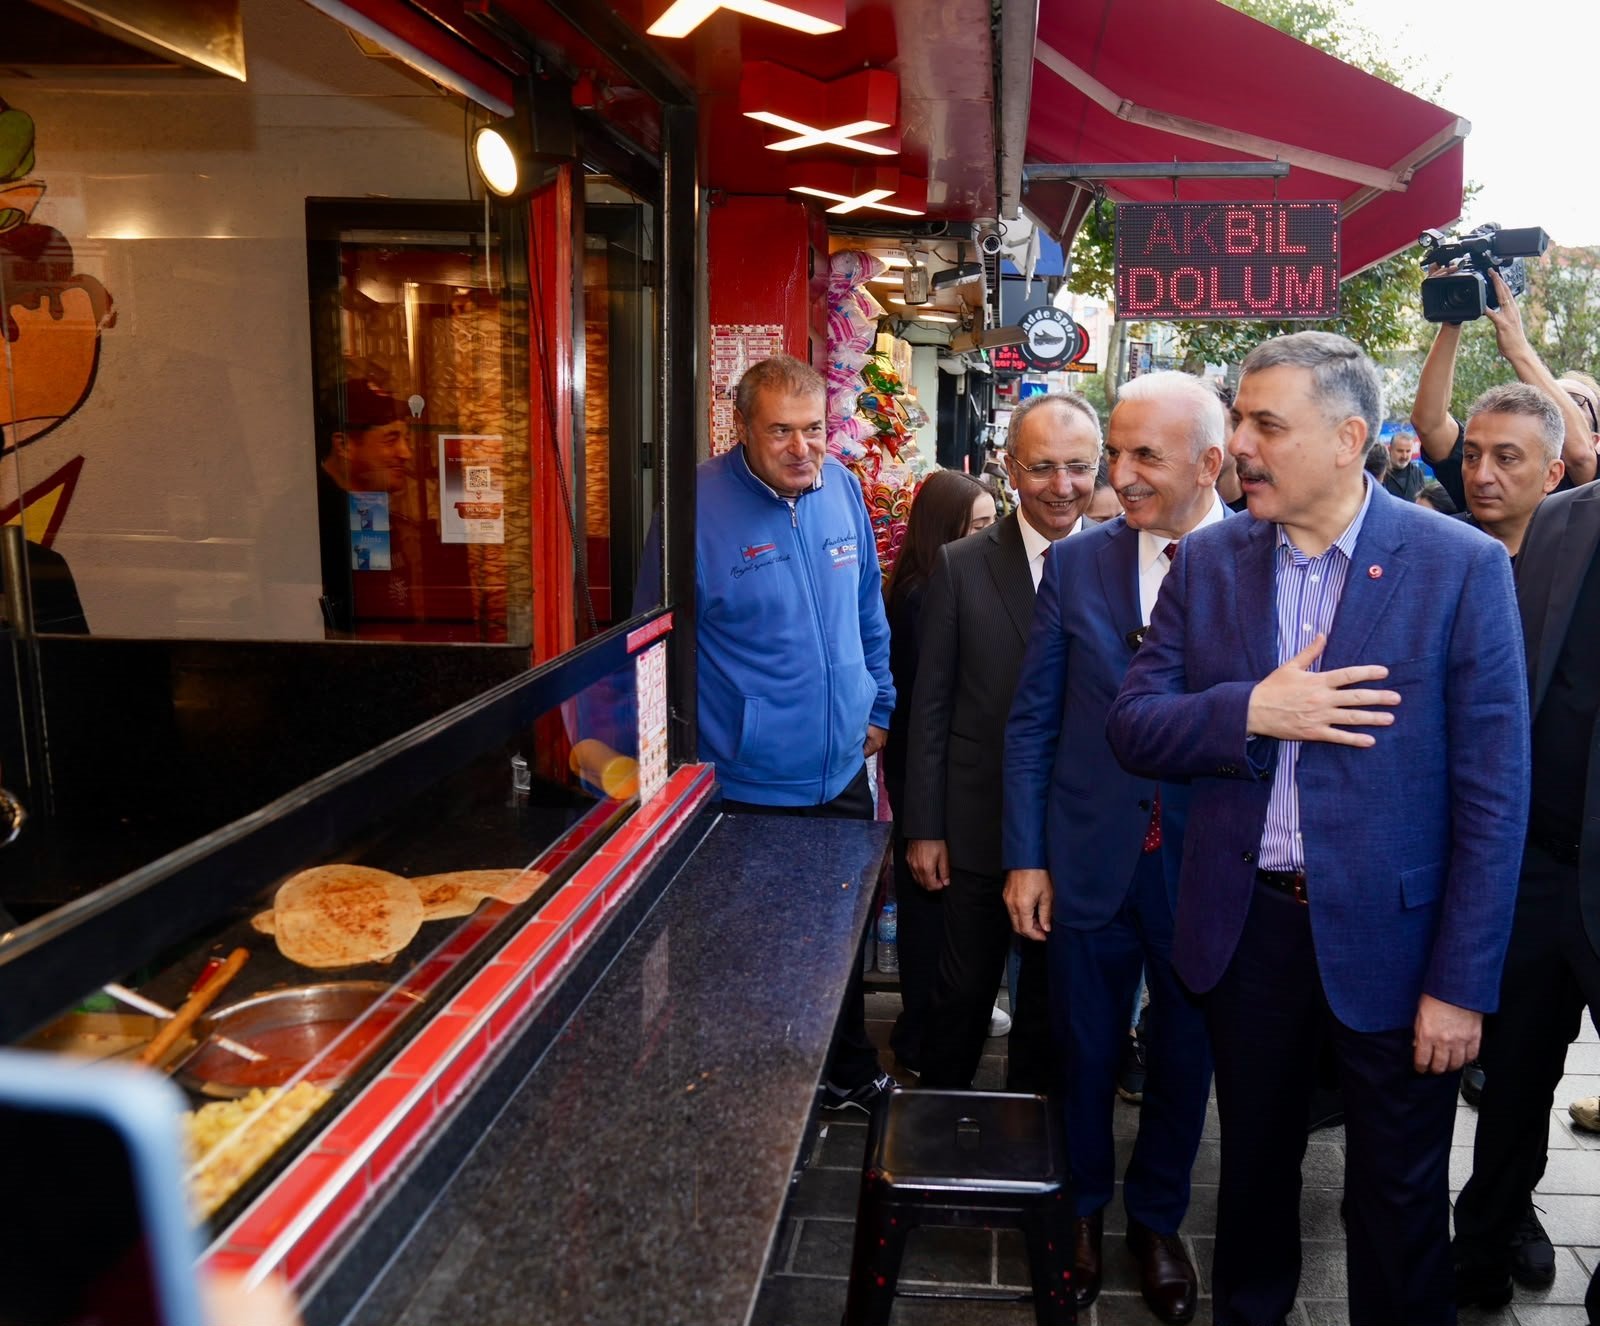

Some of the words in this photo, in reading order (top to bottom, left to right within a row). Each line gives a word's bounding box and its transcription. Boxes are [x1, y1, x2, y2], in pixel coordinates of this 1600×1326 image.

[1129, 265, 1324, 309] DOLUM
[1022, 309, 1051, 335] adde
[1053, 310, 1076, 339] Spor
